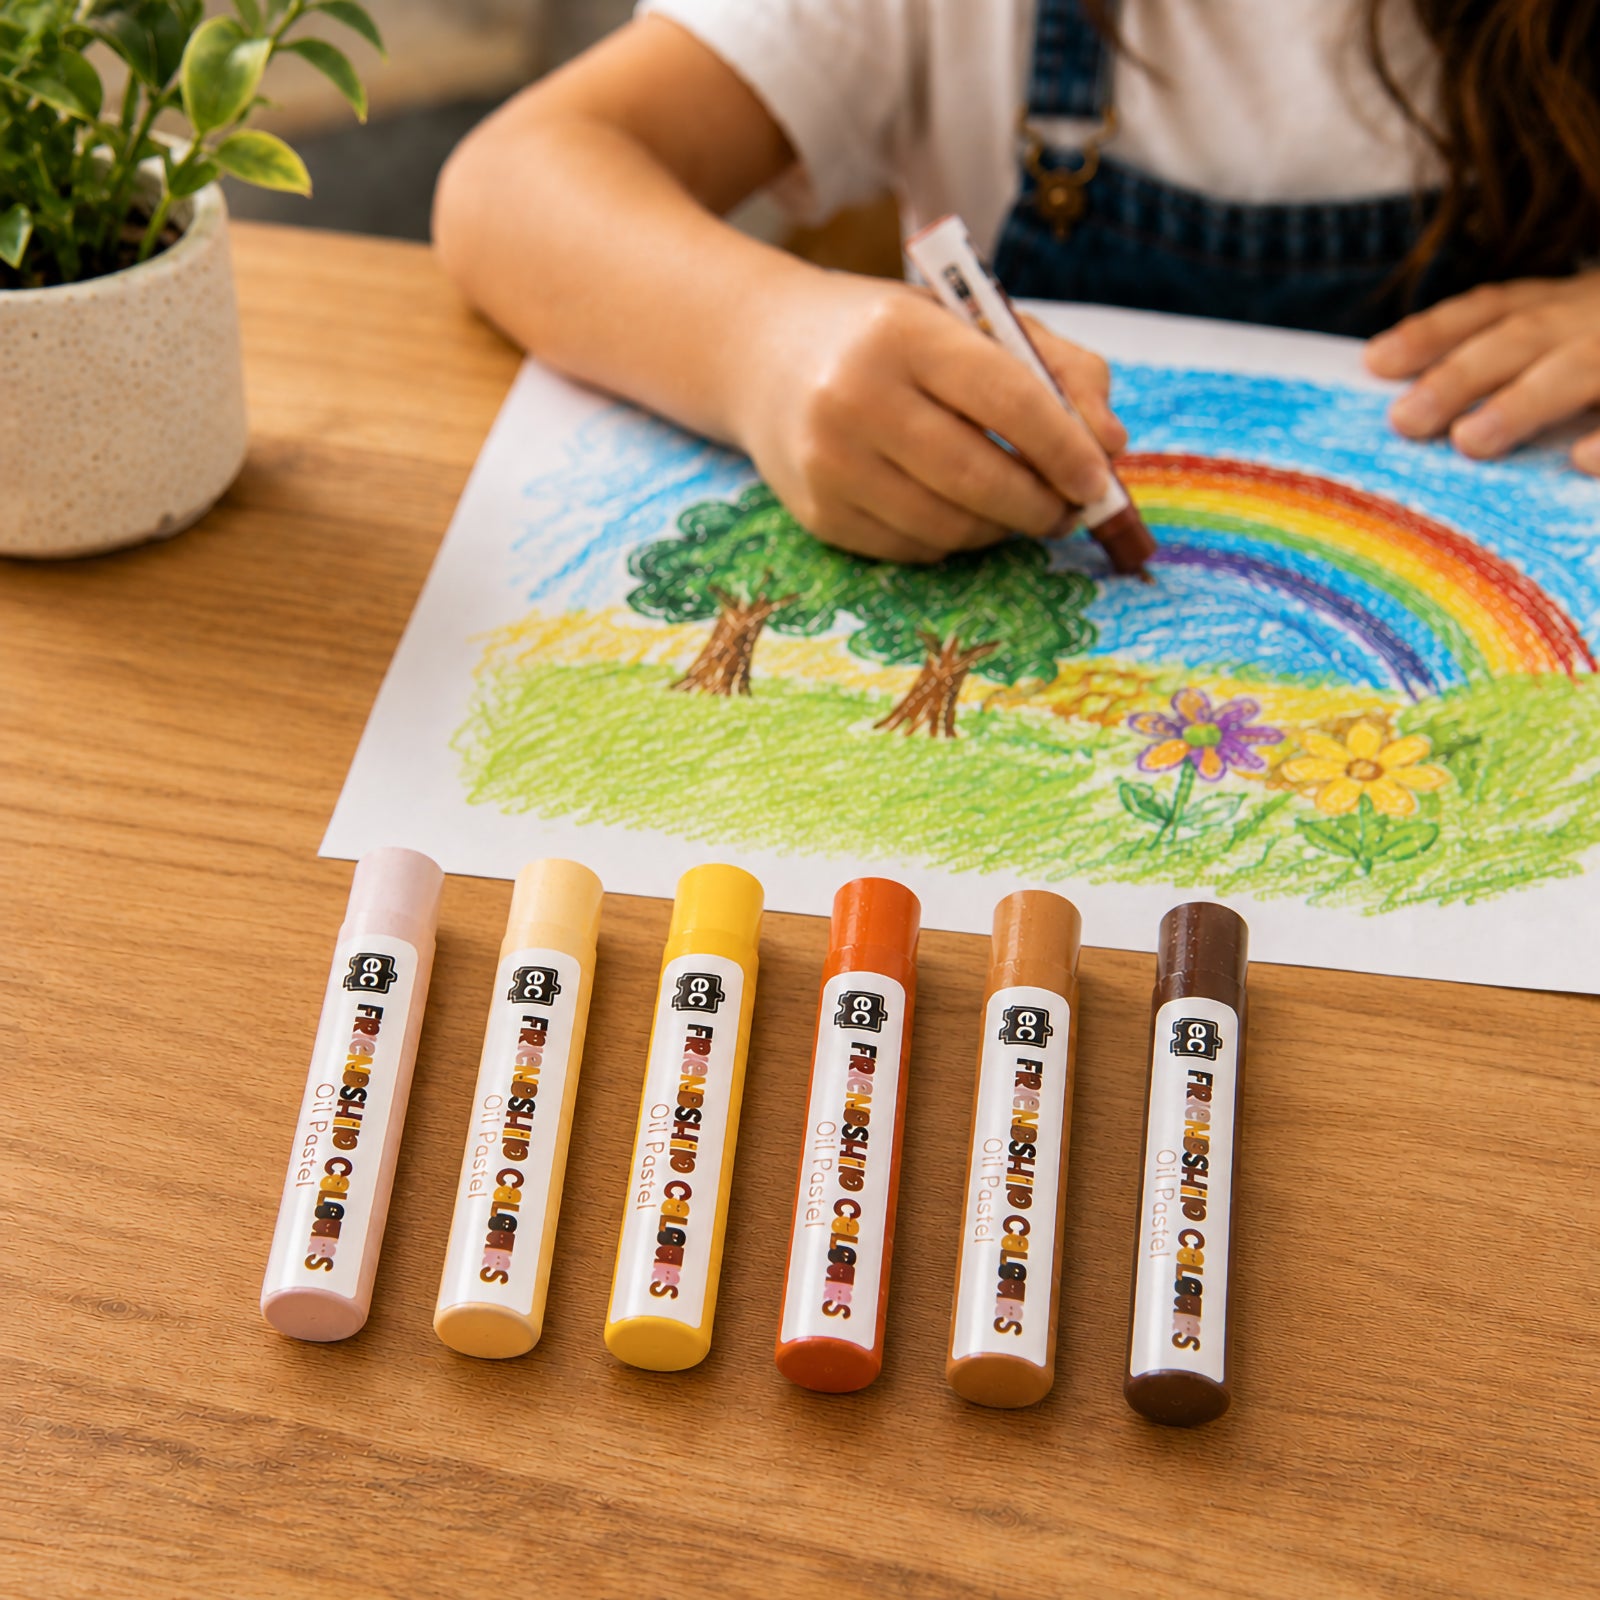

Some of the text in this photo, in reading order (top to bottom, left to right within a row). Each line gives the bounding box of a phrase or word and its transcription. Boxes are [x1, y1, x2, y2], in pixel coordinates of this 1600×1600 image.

[362, 958, 382, 987] ec
[524, 970, 546, 999] ec
[687, 977, 709, 1007] ec
[853, 995, 873, 1025] ec
[1016, 1010, 1037, 1041] ec
[1186, 1022, 1207, 1053] ec
[295, 1083, 335, 1188] Oil Pastel
[467, 1094, 503, 1199] Oil Pastel
[636, 1103, 670, 1211] Oil Pastel
[804, 1120, 837, 1229] Oil Pastel
[974, 1137, 1004, 1244] Oil Pastel
[1150, 1149, 1177, 1259] Oil Pastel
